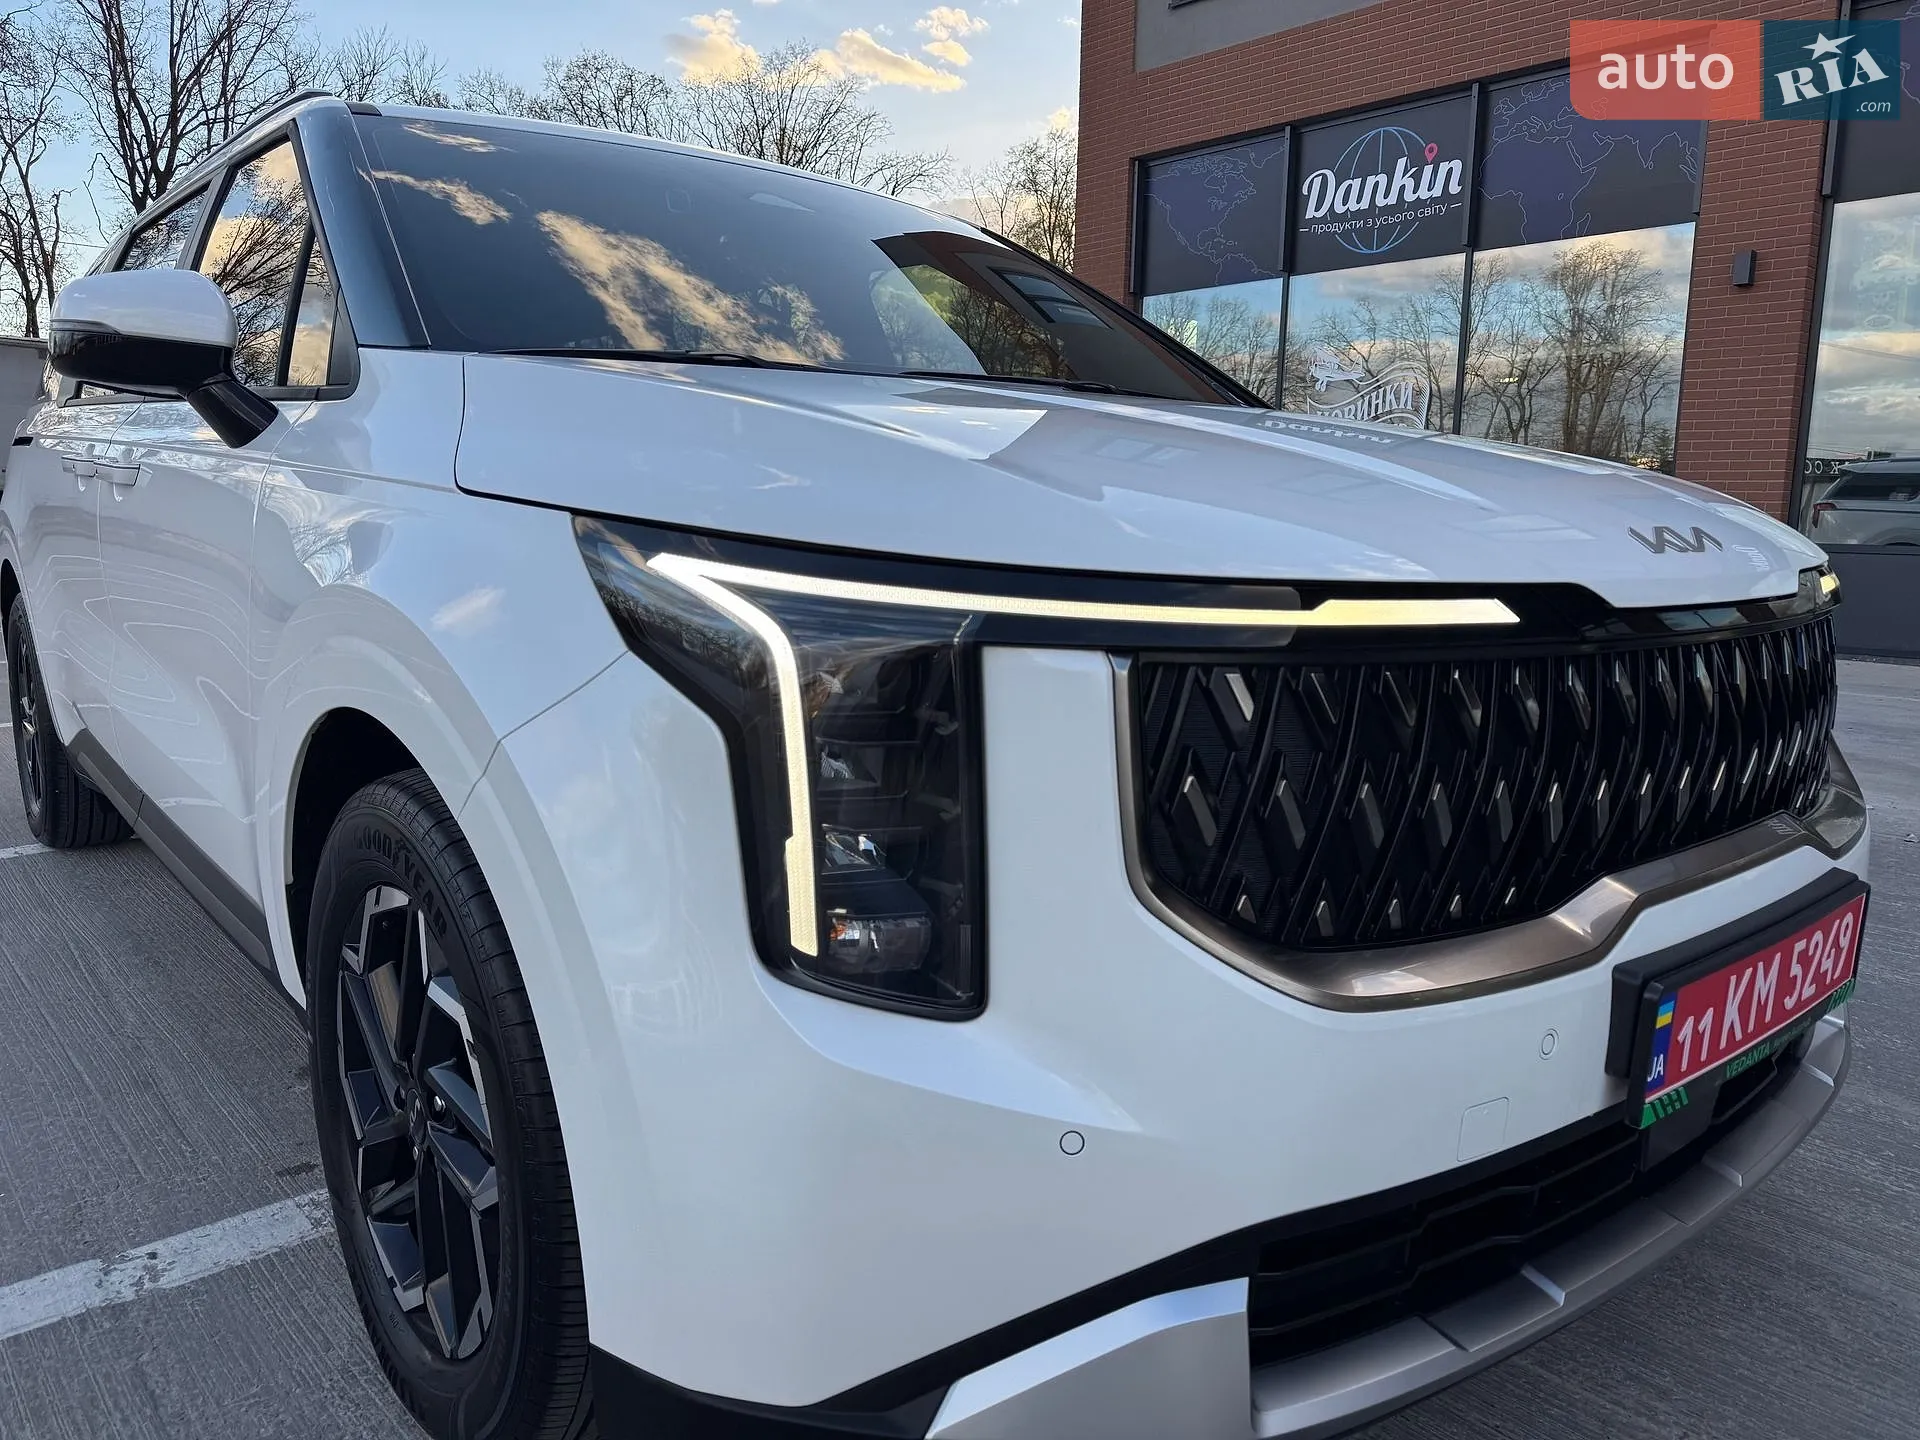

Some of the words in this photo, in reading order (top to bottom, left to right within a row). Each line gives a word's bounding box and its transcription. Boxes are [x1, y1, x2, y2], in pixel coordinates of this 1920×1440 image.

[1302, 156, 1463, 219] Dankin
[1311, 218, 1364, 235] продукти
[1366, 218, 1373, 228] з
[1375, 211, 1415, 229] усього
[1417, 202, 1448, 218] світу
[1316, 381, 1415, 420] ВИНКИ
[1677, 1007, 1715, 1073] 11
[1719, 952, 1781, 1050] KM
[1783, 911, 1855, 1011] 5249
